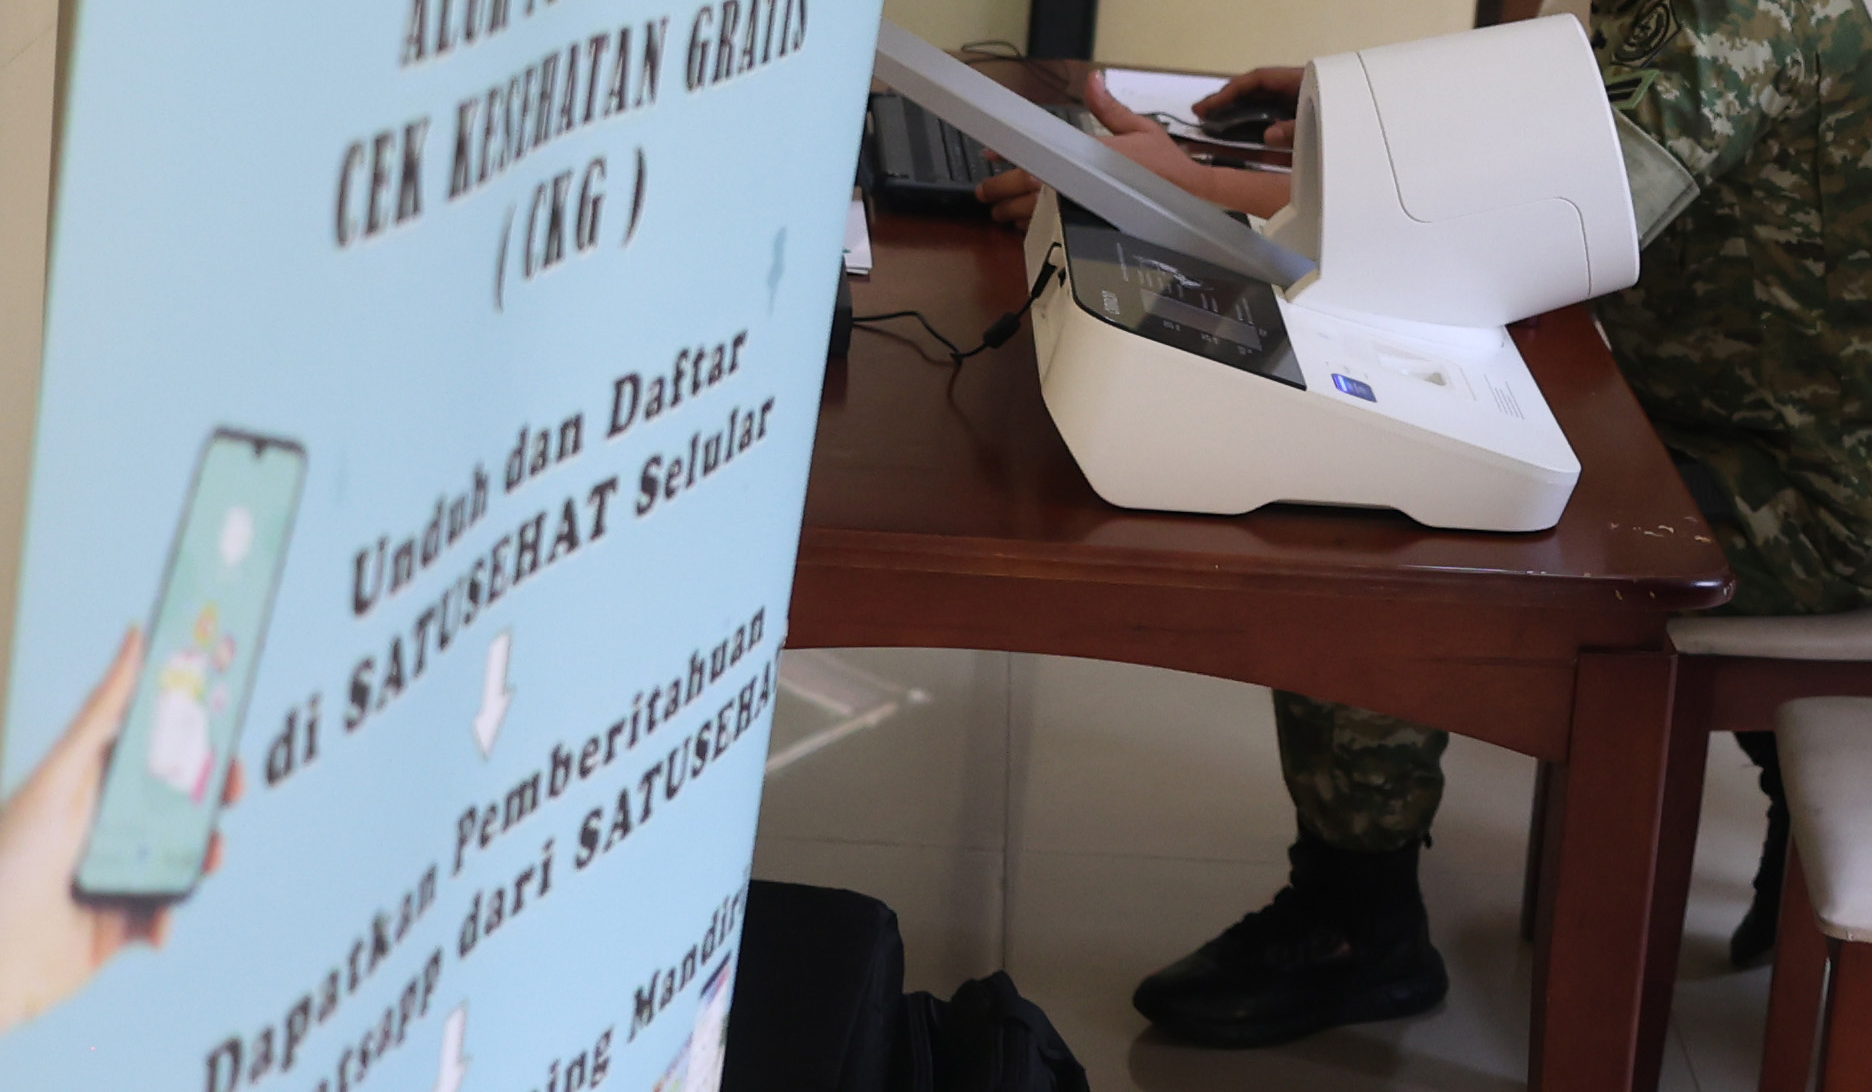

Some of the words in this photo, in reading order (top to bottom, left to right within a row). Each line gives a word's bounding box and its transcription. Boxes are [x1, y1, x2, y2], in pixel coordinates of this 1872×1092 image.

[335, 115, 431, 250] CEK
[447, 15, 669, 204] KESEHATAN
[264, 692, 322, 789] di
[343, 475, 619, 733] SATUSEHAT
[635, 396, 775, 517] Selular
[352, 459, 489, 618] Unduh
[504, 412, 585, 495] dan
[606, 329, 748, 440] Daftar
[204, 863, 437, 1092] Dapatkan
[453, 605, 765, 879] Pemberitahuan
[458, 837, 556, 959] dari
